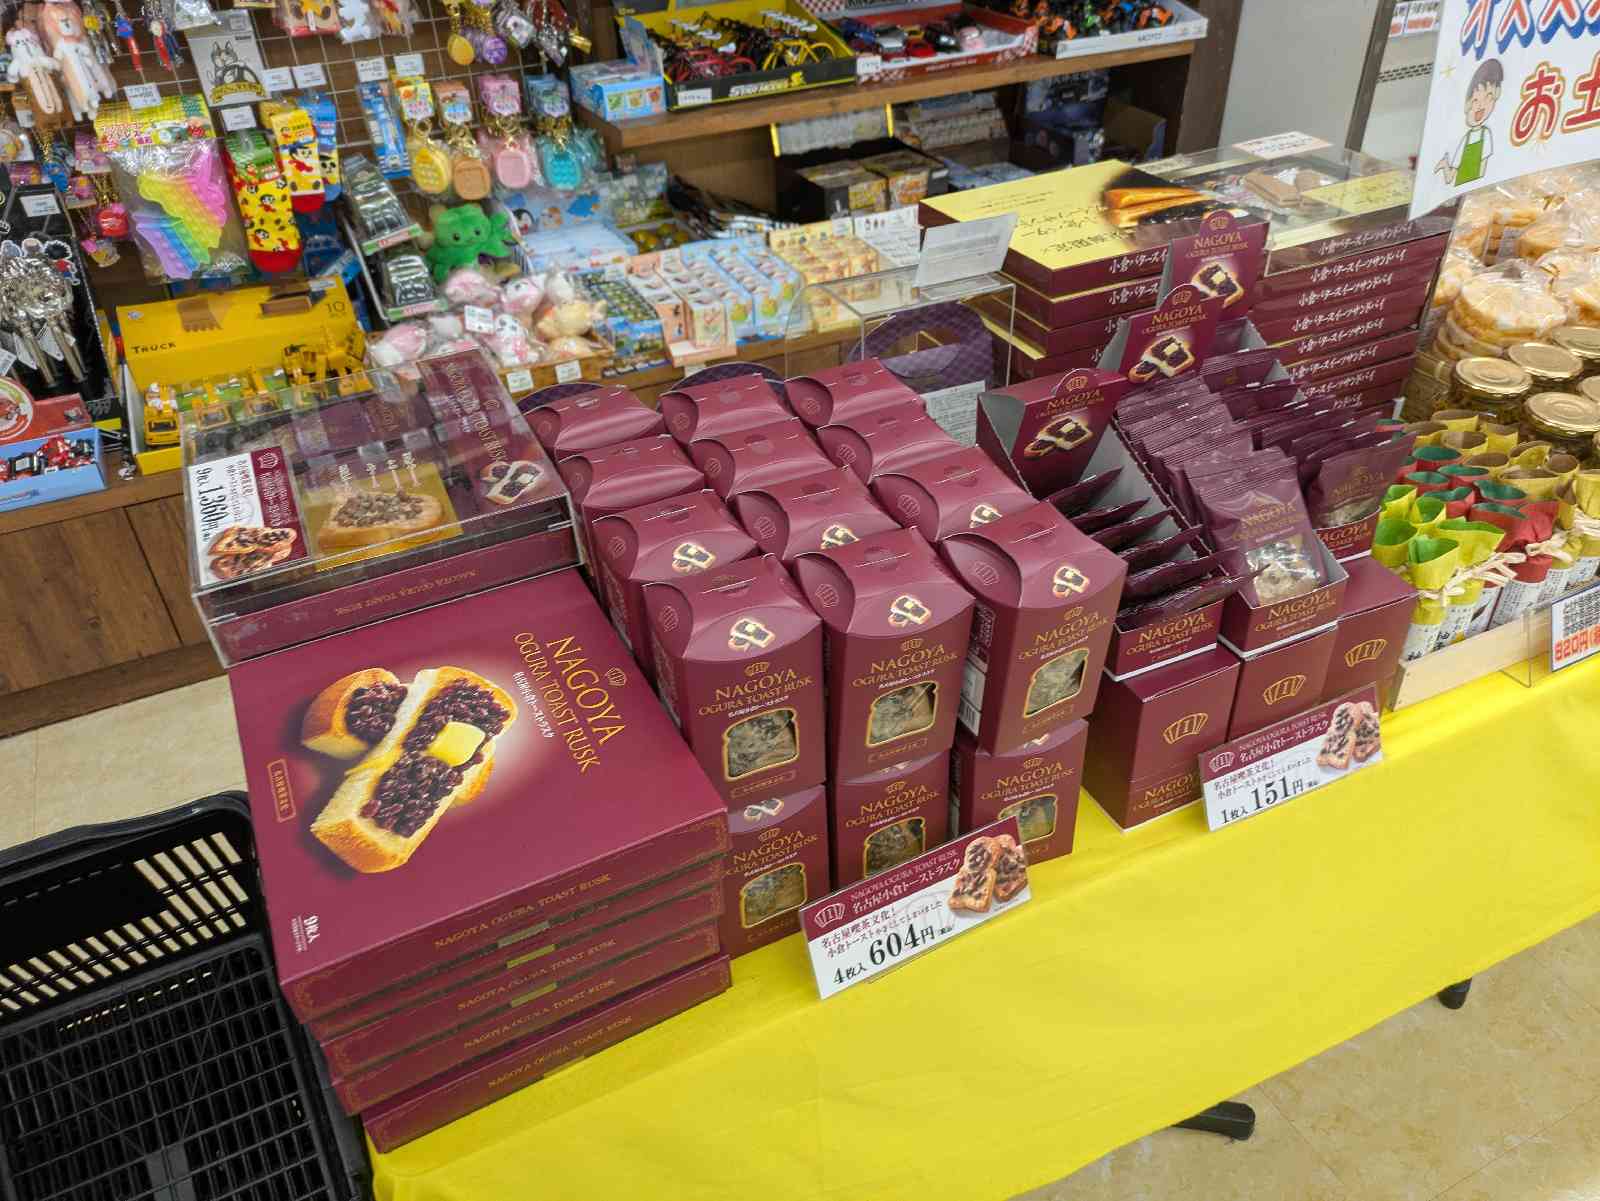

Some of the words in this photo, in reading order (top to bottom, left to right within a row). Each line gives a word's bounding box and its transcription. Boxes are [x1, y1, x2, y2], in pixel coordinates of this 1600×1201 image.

[1193, 232, 1242, 249] NAGOYA
[1151, 304, 1203, 326] NAGOYA
[132, 341, 176, 355] TRUCK
[1047, 389, 1101, 411] NAGOYA
[1268, 591, 1329, 621] NAGOYA
[1035, 612, 1099, 645] NAGOYA
[1138, 613, 1206, 643] NAGOYA
[852, 674, 897, 688] OGURA
[897, 662, 930, 678] TOAST
[870, 644, 945, 674] NAGOYA
[546, 634, 627, 747] NAGOYA
[698, 698, 744, 717] OGURA
[744, 687, 782, 706] TOAST
[783, 675, 813, 694] RUSK
[715, 668, 797, 701] NAGOYA
[513, 631, 551, 682] OGURA
[540, 679, 578, 727] TOAST
[563, 727, 601, 774] RUSK
[996, 760, 1063, 790] NAGOYA
[860, 784, 927, 815] NAGOYA
[1221, 807, 1248, 825] 1枚入
[1251, 775, 1304, 812] 151円
[733, 830, 805, 864] NAGOYA
[851, 858, 961, 914] 名古屋小倉トーストラスク
[434, 923, 490, 948] NAGOYA
[539, 886, 577, 909] TOAST
[834, 962, 868, 985] 4枚入
[870, 922, 935, 966] 604円
